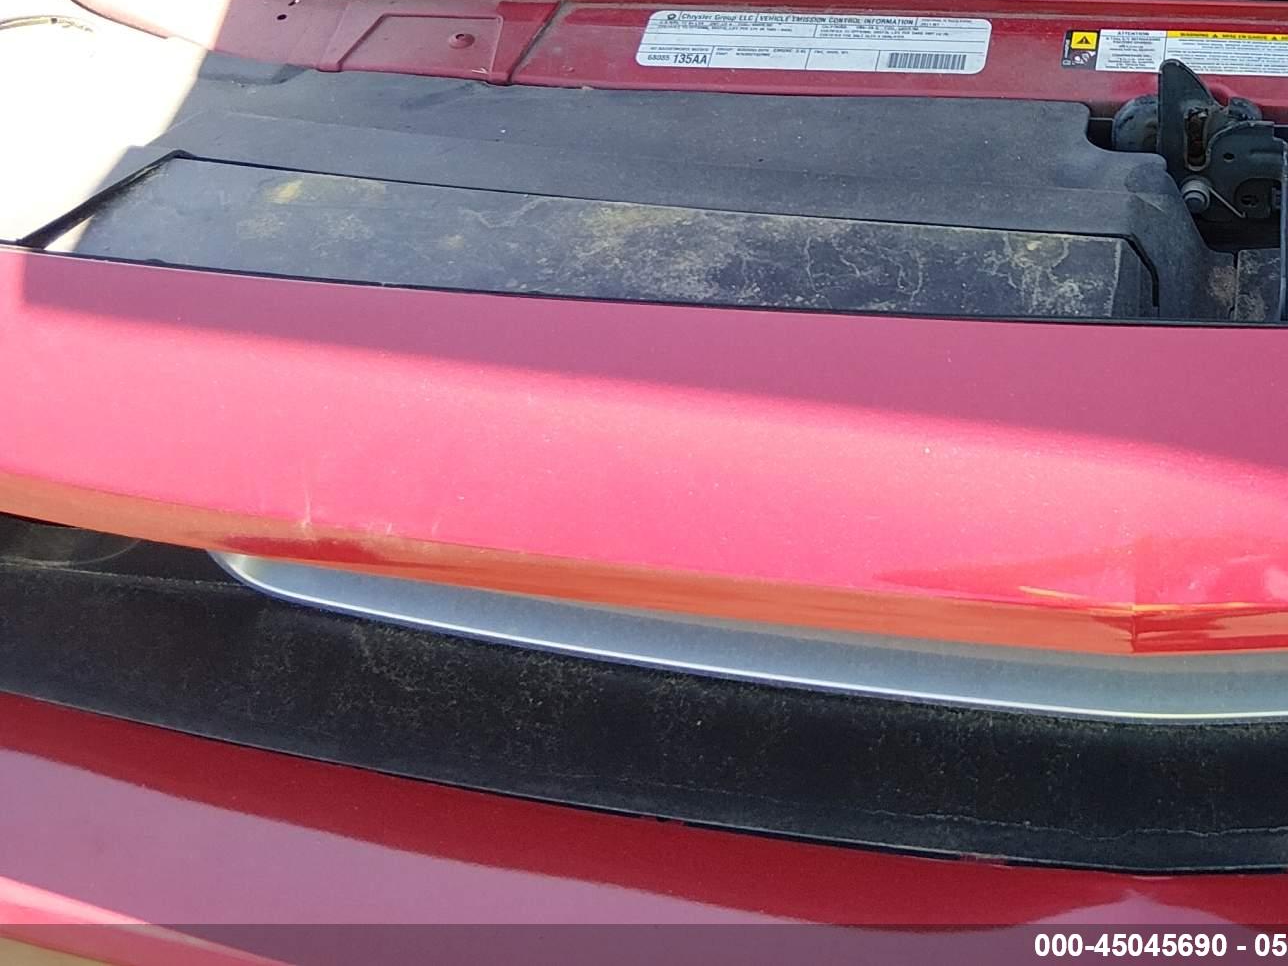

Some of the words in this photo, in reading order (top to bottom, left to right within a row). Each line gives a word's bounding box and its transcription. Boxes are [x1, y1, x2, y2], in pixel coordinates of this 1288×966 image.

[681, 12, 713, 22] Chrysler
[714, 14, 737, 23] Group
[759, 14, 790, 22] VEHICLE
[792, 15, 825, 23] EMISSION
[864, 17, 914, 25] INFORMATION
[673, 53, 707, 64] 135AA
